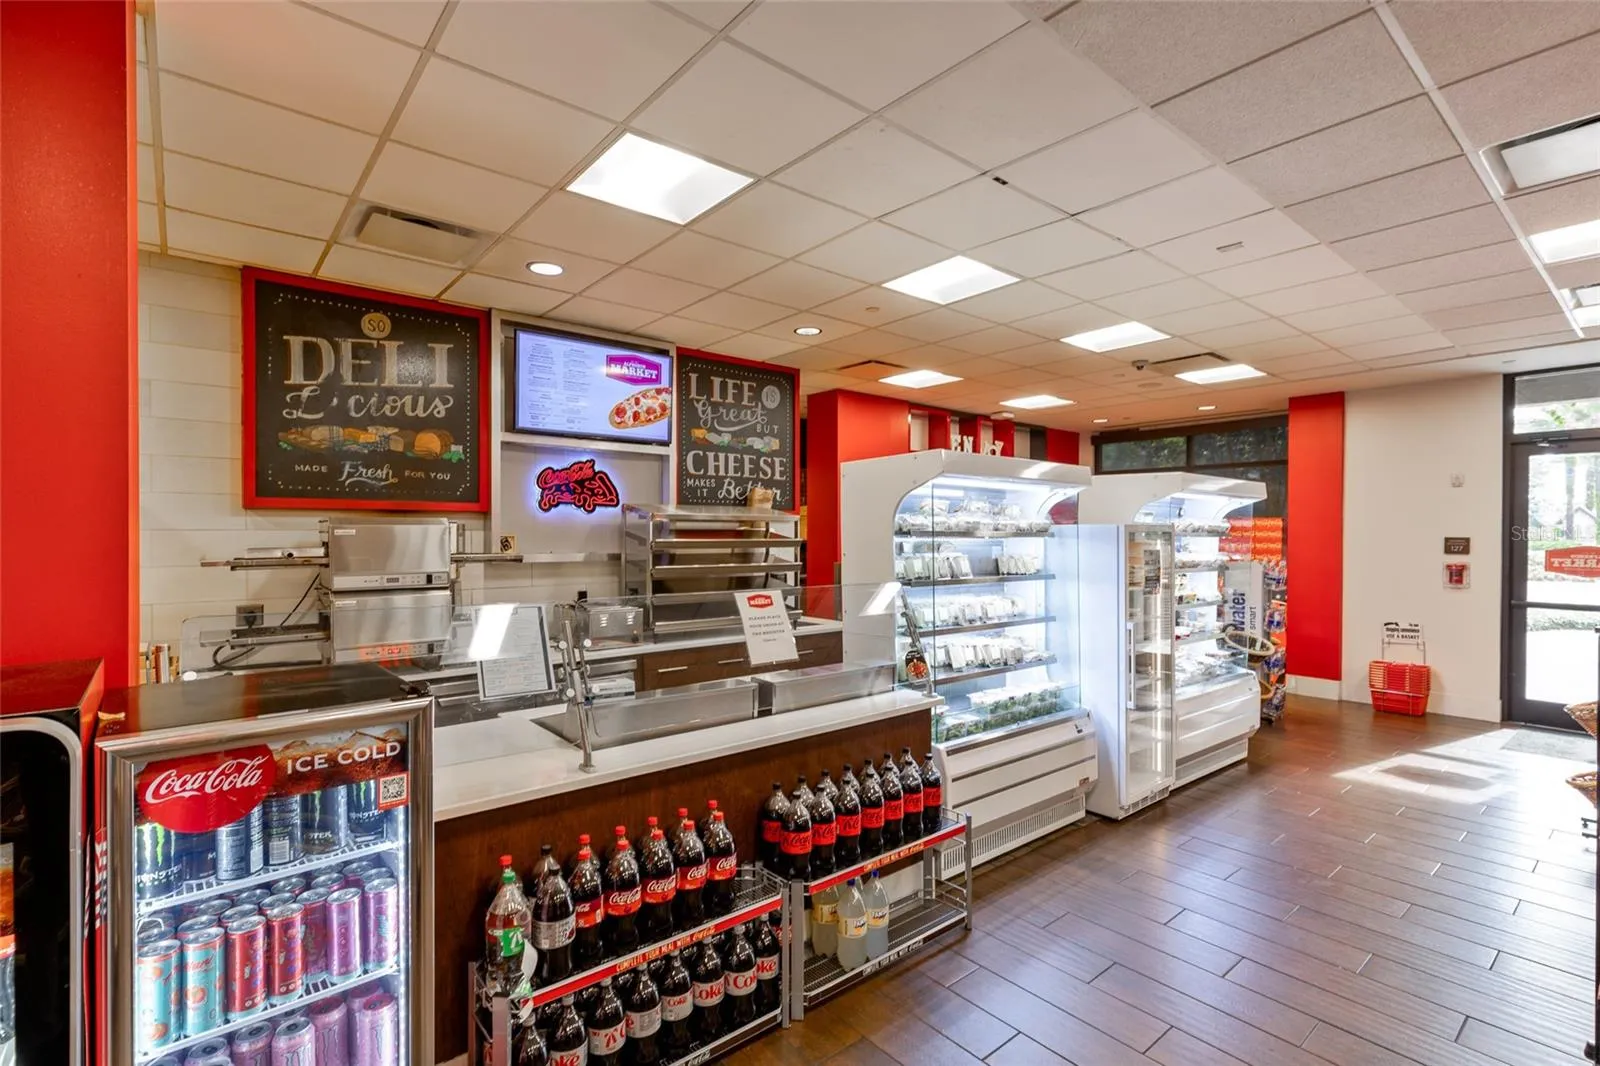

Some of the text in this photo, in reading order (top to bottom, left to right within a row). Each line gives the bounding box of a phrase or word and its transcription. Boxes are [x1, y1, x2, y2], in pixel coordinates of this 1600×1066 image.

[367, 319, 386, 332] SO
[283, 335, 454, 388] DELI
[689, 373, 757, 406] LIFE
[693, 398, 768, 431] Great
[756, 424, 779, 434] BUT
[295, 460, 451, 487] MADE Fresh FOR YOU
[686, 450, 787, 480] CHEESE
[686, 478, 716, 487] MAKES
[697, 489, 707, 497] IT
[286, 741, 401, 775] ICE COLD
[145, 754, 269, 804] Coca-Cola
